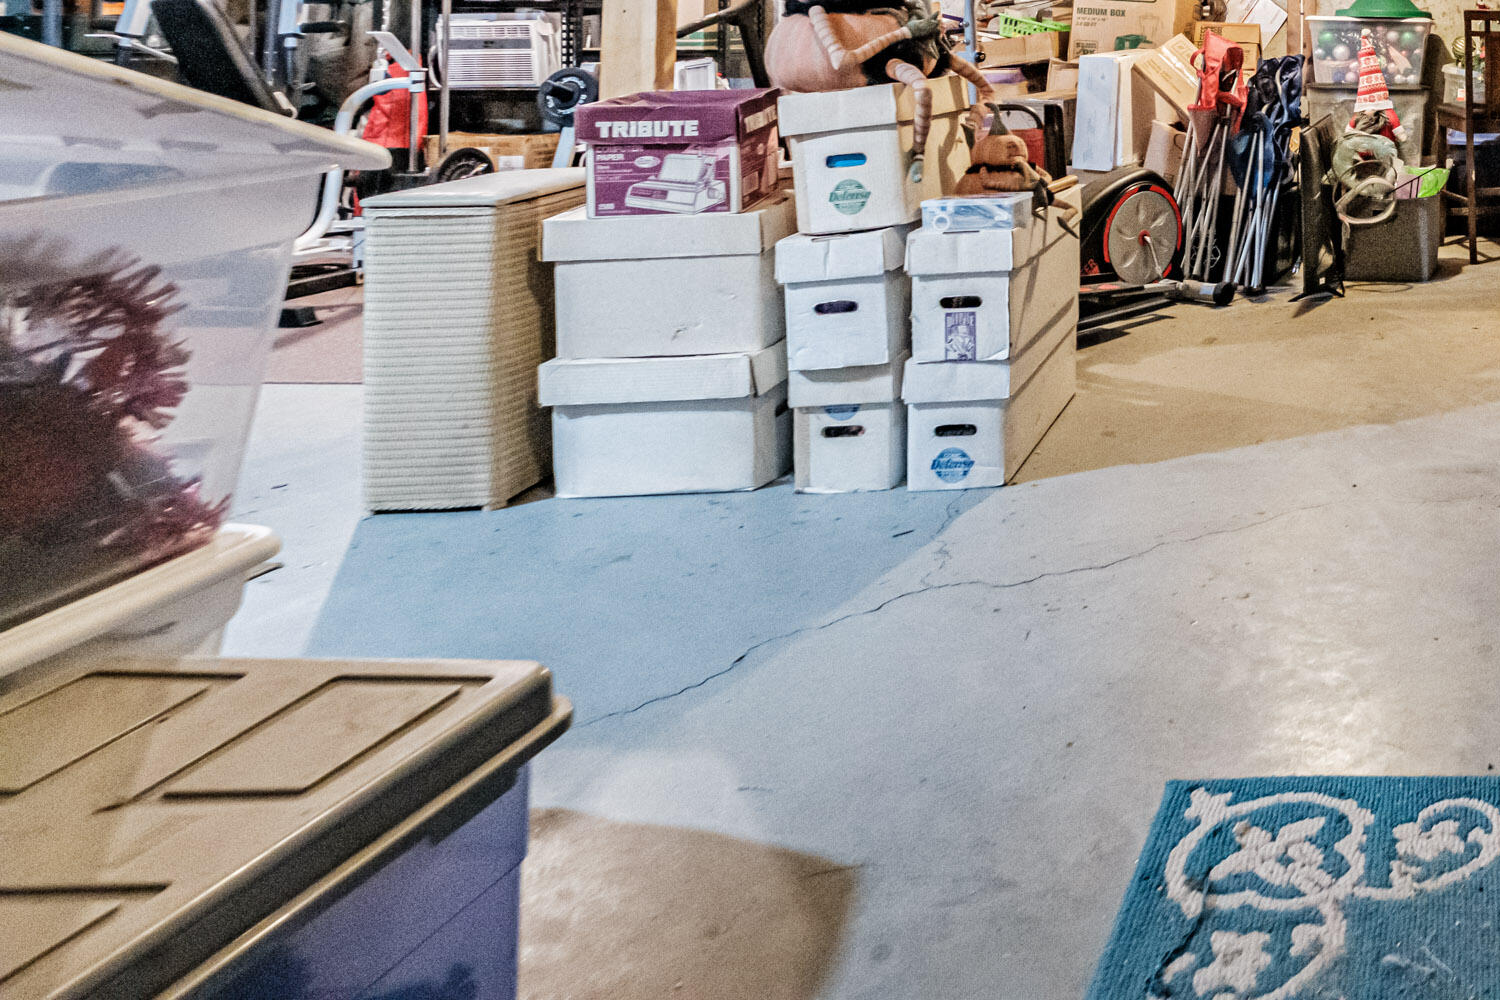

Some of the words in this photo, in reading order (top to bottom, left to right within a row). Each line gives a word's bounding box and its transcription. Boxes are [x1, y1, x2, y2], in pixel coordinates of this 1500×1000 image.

[1077, 7, 1107, 16] MEDIUM
[1110, 9, 1126, 17] BOX
[595, 120, 699, 138] TRIBUTE
